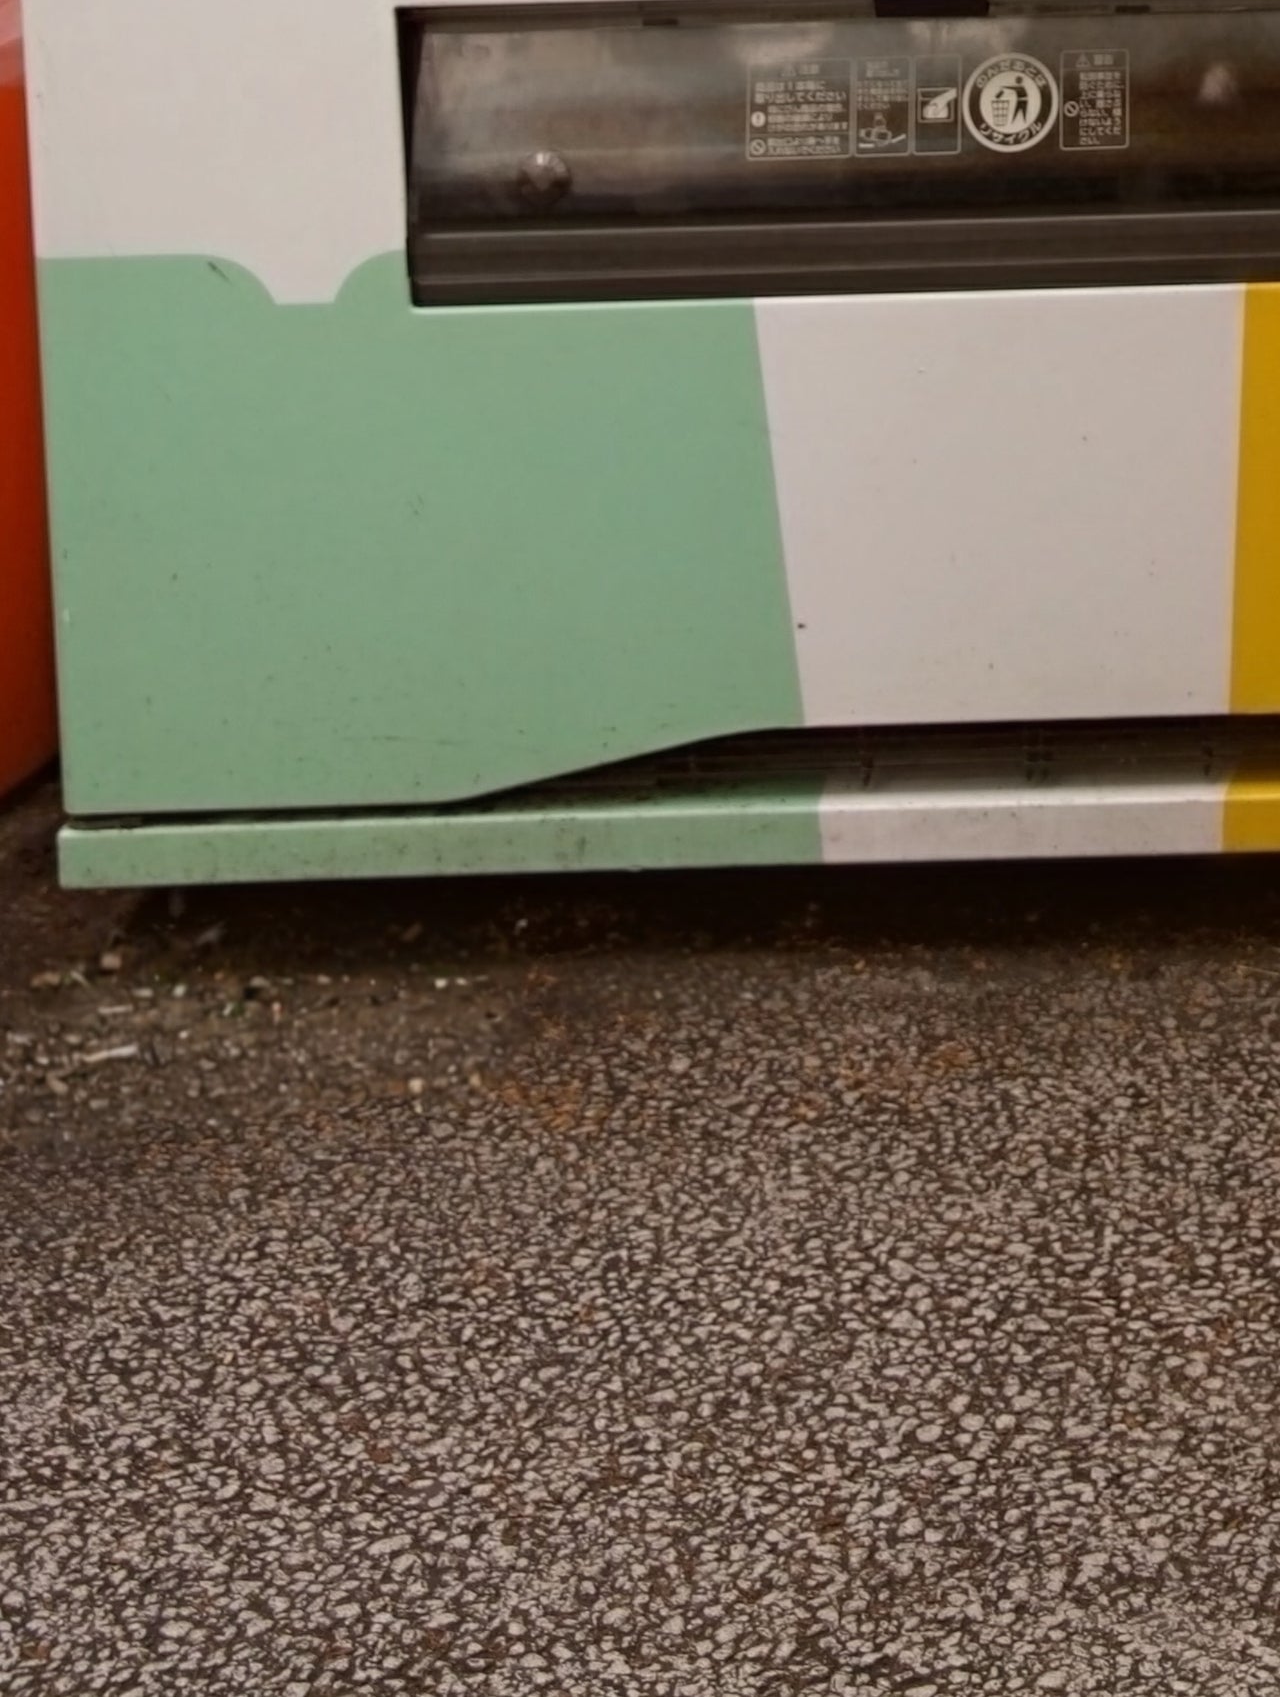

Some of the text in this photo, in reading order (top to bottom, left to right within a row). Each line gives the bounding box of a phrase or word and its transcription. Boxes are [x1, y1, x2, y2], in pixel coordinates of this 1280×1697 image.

[978, 121, 1045, 148] リサイクル
